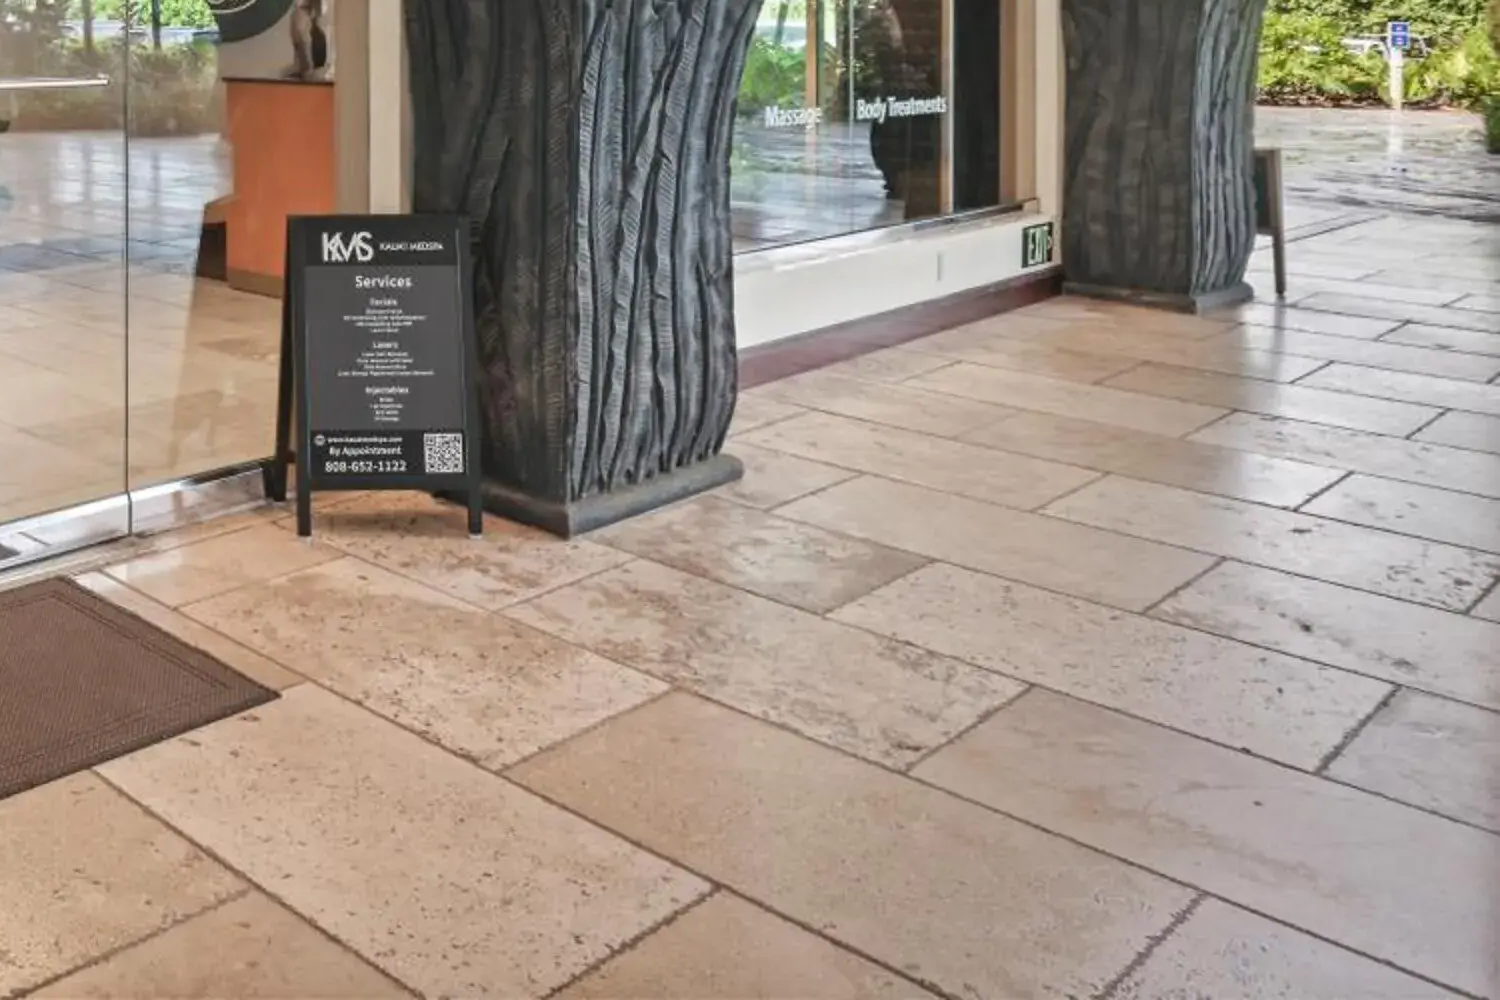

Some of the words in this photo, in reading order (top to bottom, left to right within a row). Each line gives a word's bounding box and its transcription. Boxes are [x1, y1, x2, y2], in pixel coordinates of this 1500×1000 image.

[765, 105, 823, 130] Massage
[856, 97, 886, 124] Body
[888, 96, 947, 117] Treatments
[1028, 226, 1049, 265] EXIT
[355, 275, 413, 289] Services
[342, 446, 403, 456] Appointment
[325, 460, 407, 472] 808-652-1122
